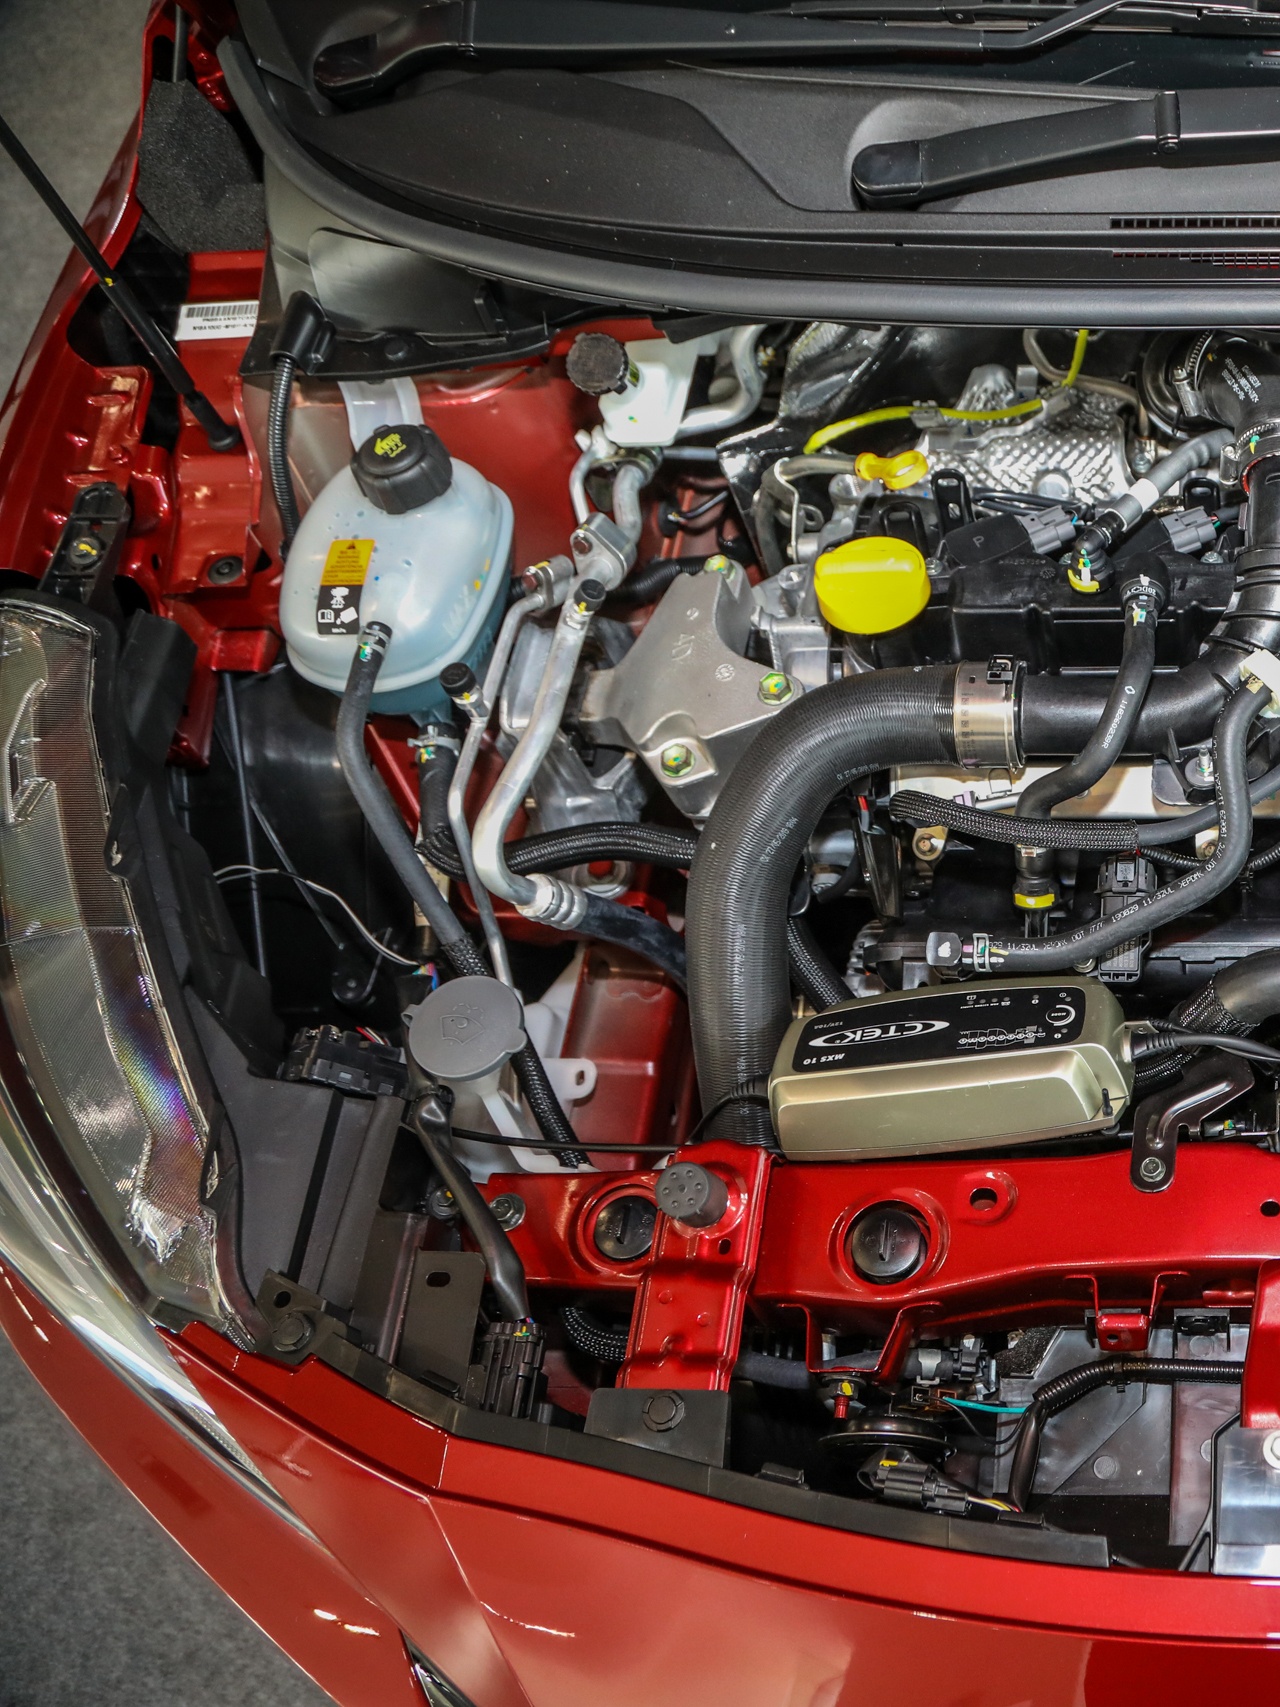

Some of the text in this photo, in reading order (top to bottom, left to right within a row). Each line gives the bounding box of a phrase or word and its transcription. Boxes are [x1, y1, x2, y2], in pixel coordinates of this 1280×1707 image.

[841, 1023, 924, 1044] CTEK
[802, 1053, 846, 1066] MXS 10
